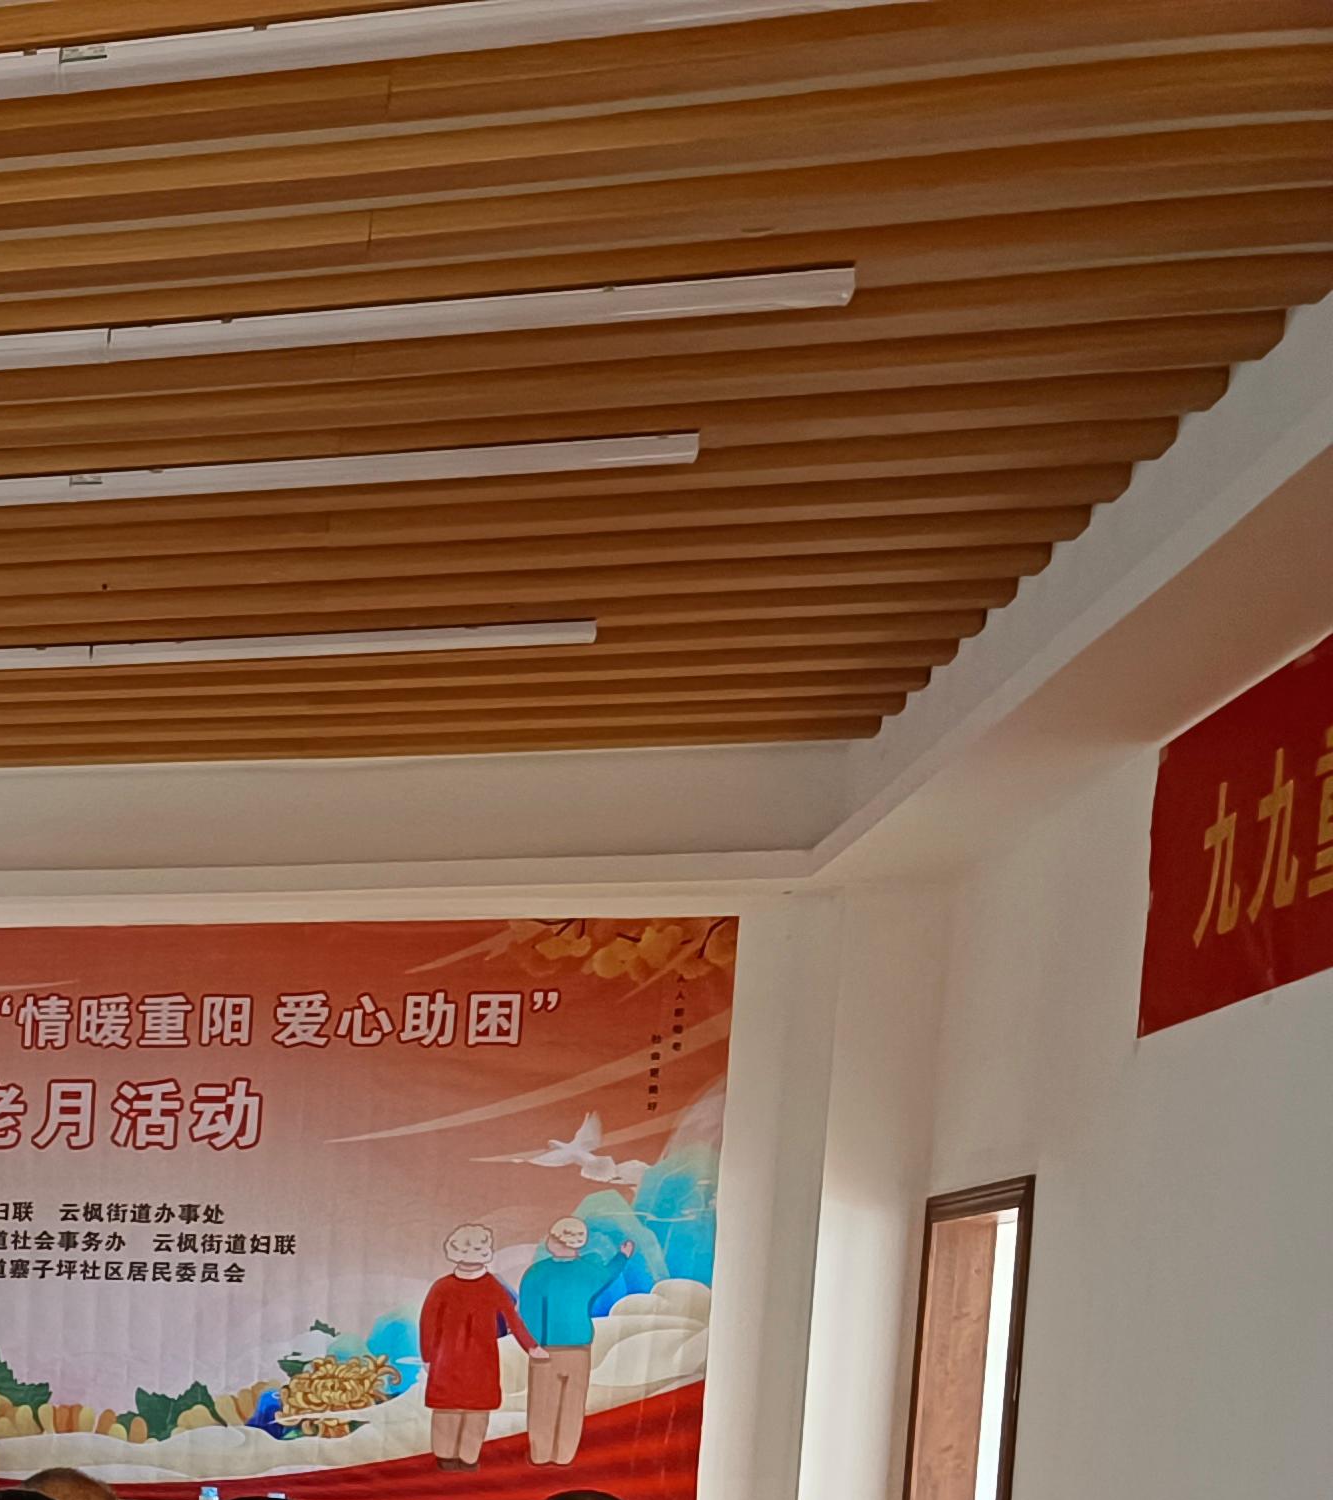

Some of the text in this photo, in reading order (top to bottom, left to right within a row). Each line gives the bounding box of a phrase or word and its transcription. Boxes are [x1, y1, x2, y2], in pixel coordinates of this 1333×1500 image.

[59, 1203, 226, 1225] 云枫街道办事处
[152, 1232, 297, 1257] 云枫街道妇联
